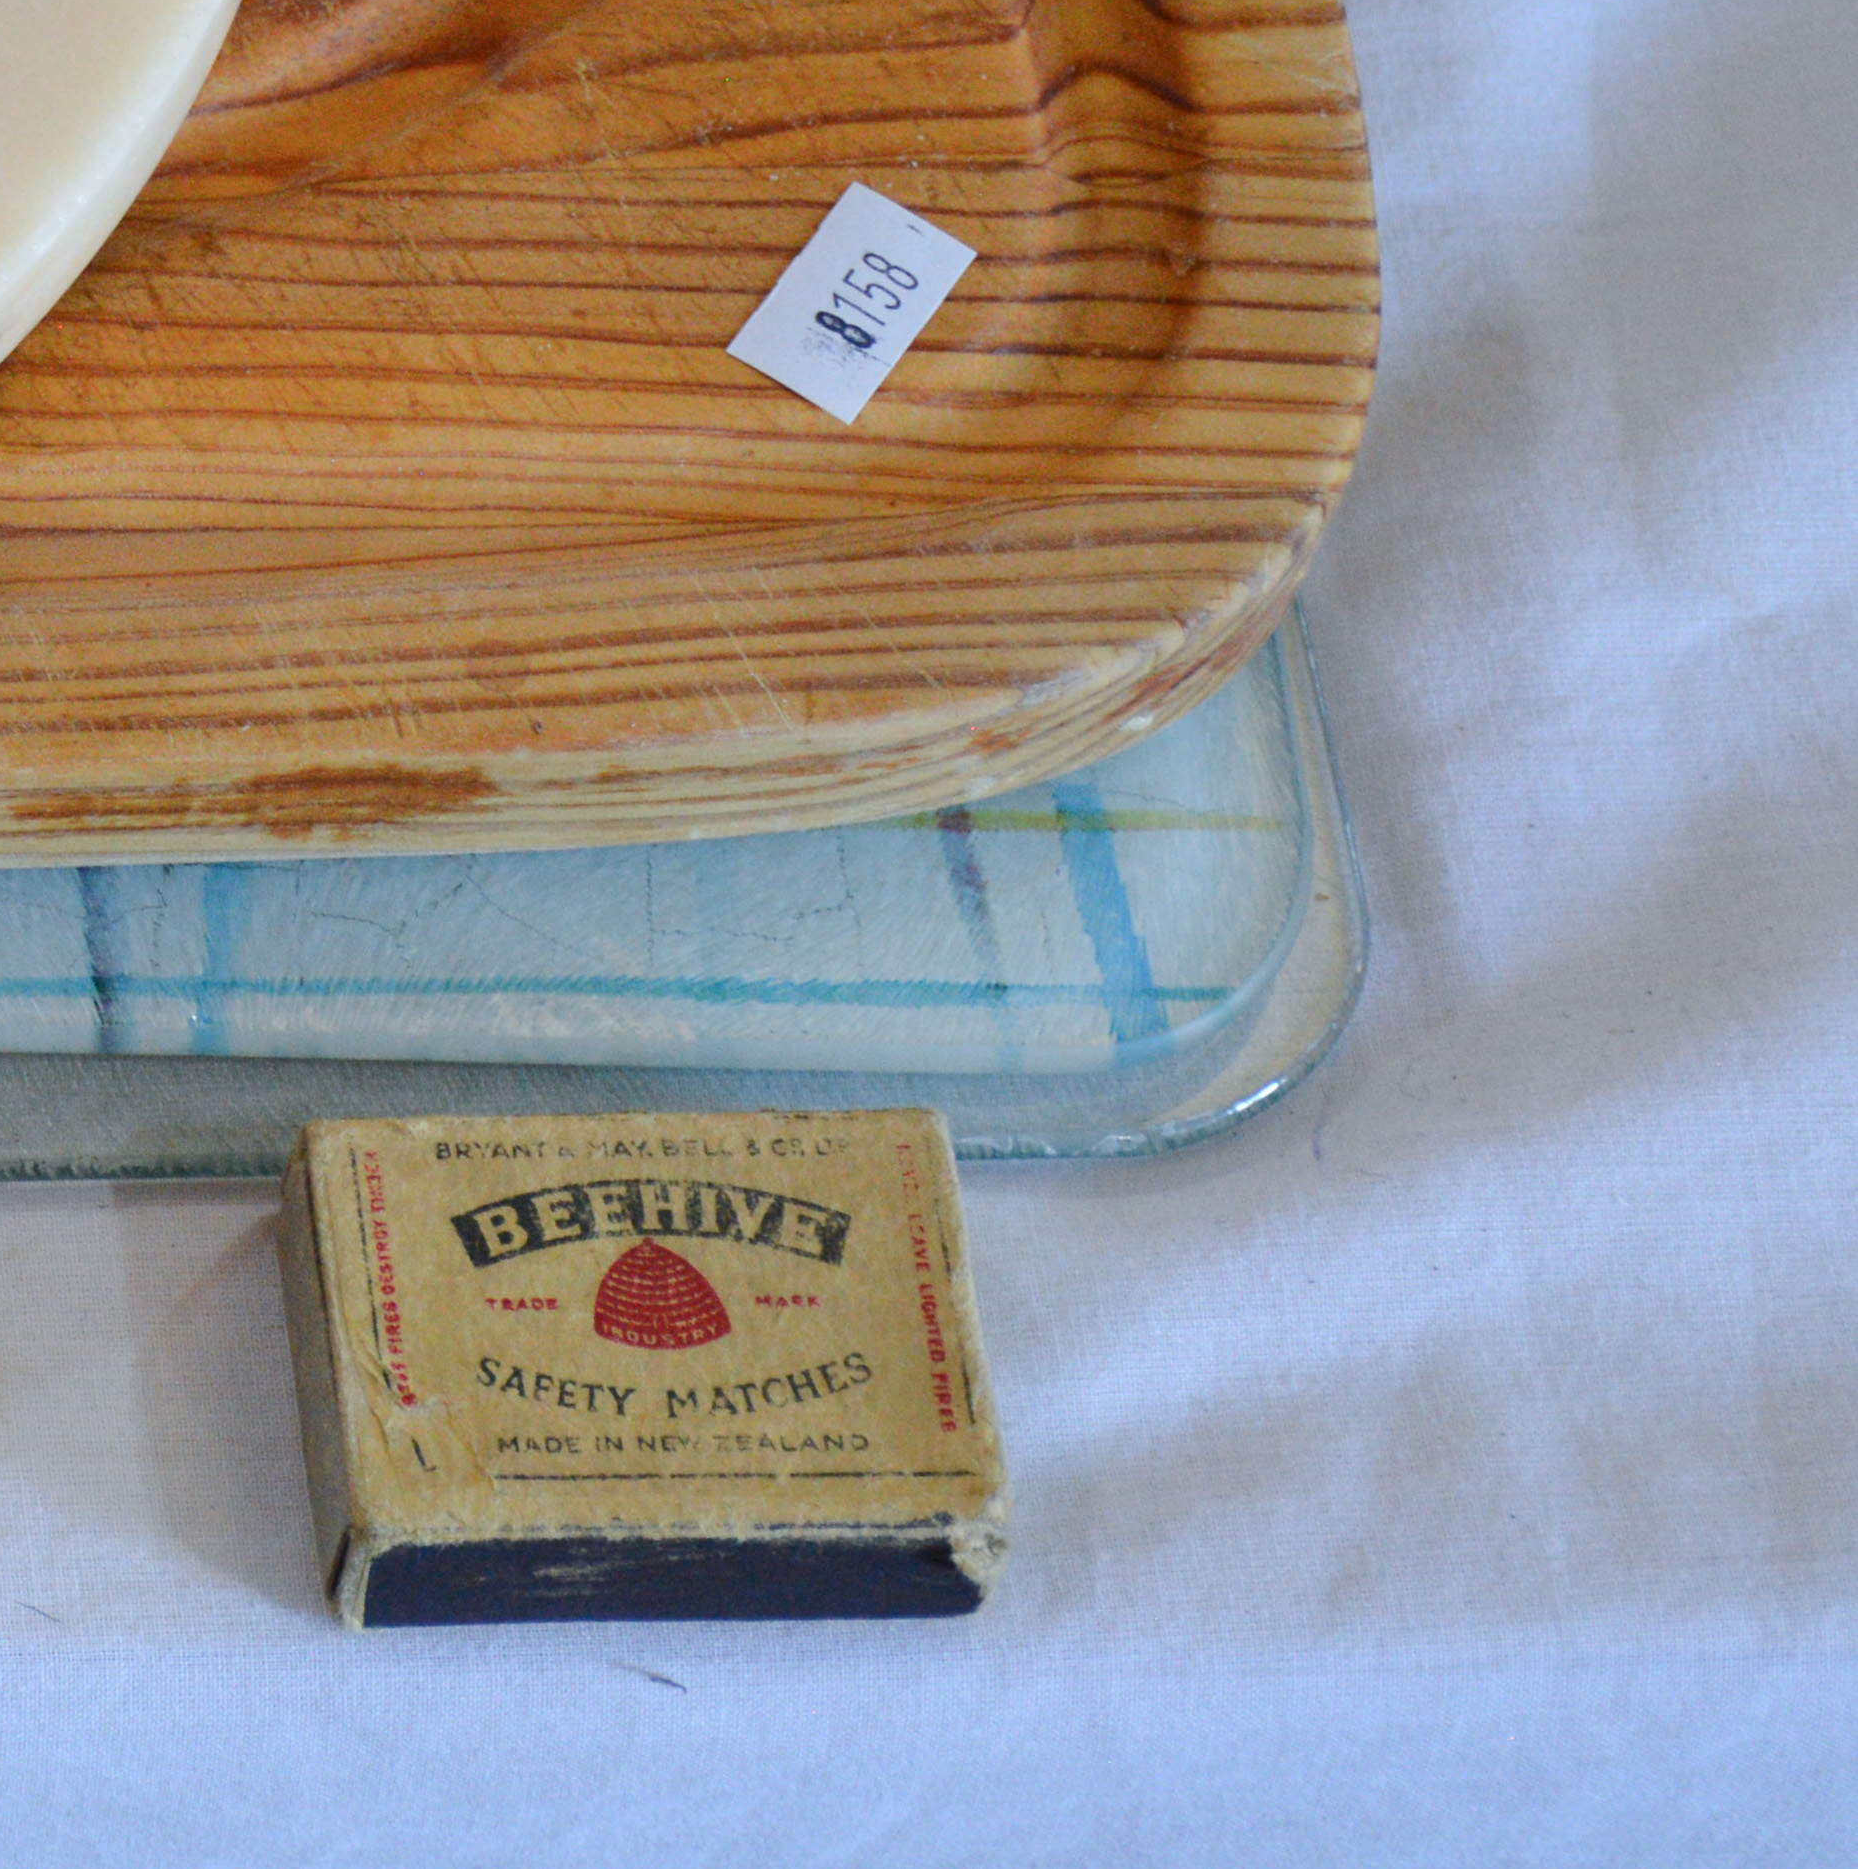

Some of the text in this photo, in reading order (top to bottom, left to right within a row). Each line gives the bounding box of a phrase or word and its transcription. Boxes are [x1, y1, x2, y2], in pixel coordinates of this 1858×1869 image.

[815, 251, 919, 349] 8158
[435, 1140, 546, 1160] BRYANT
[746, 1138, 761, 1158] &
[473, 1184, 829, 1258] BEEHIVE
[372, 1218, 396, 1297] DESTROY
[485, 1294, 822, 1313] TRADE MARK
[602, 1323, 718, 1346] INDUSTRY
[919, 1282, 947, 1364] LIGHTED
[476, 1351, 873, 1419] SAFETY MATCHES
[497, 1433, 870, 1454] MADE IN NEW ZEALAND
